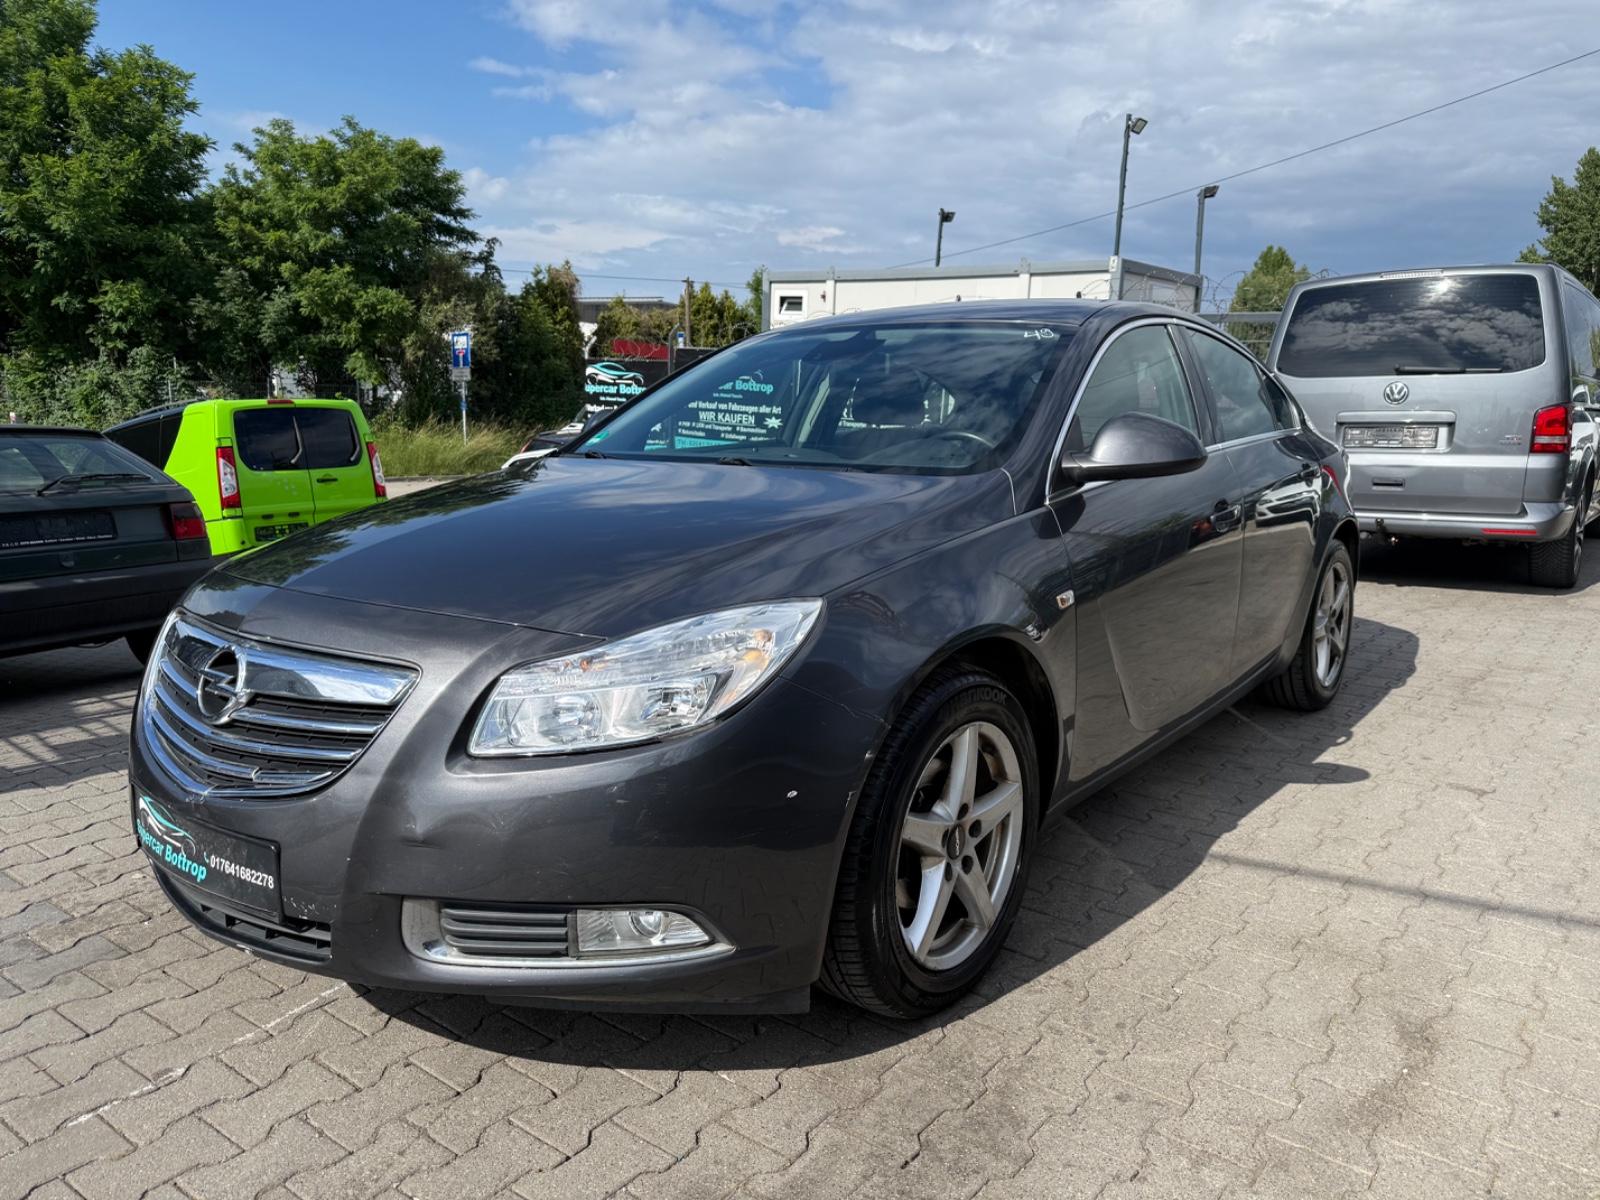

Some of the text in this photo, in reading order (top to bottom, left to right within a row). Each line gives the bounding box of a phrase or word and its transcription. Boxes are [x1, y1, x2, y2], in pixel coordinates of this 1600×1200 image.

[584, 384, 618, 394] upercar
[735, 380, 774, 394] Bottrop
[772, 405, 782, 415] Art
[698, 411, 755, 425] WIR KAUFEN
[165, 845, 207, 882] Bottrop
[210, 855, 274, 889] 017641682278
